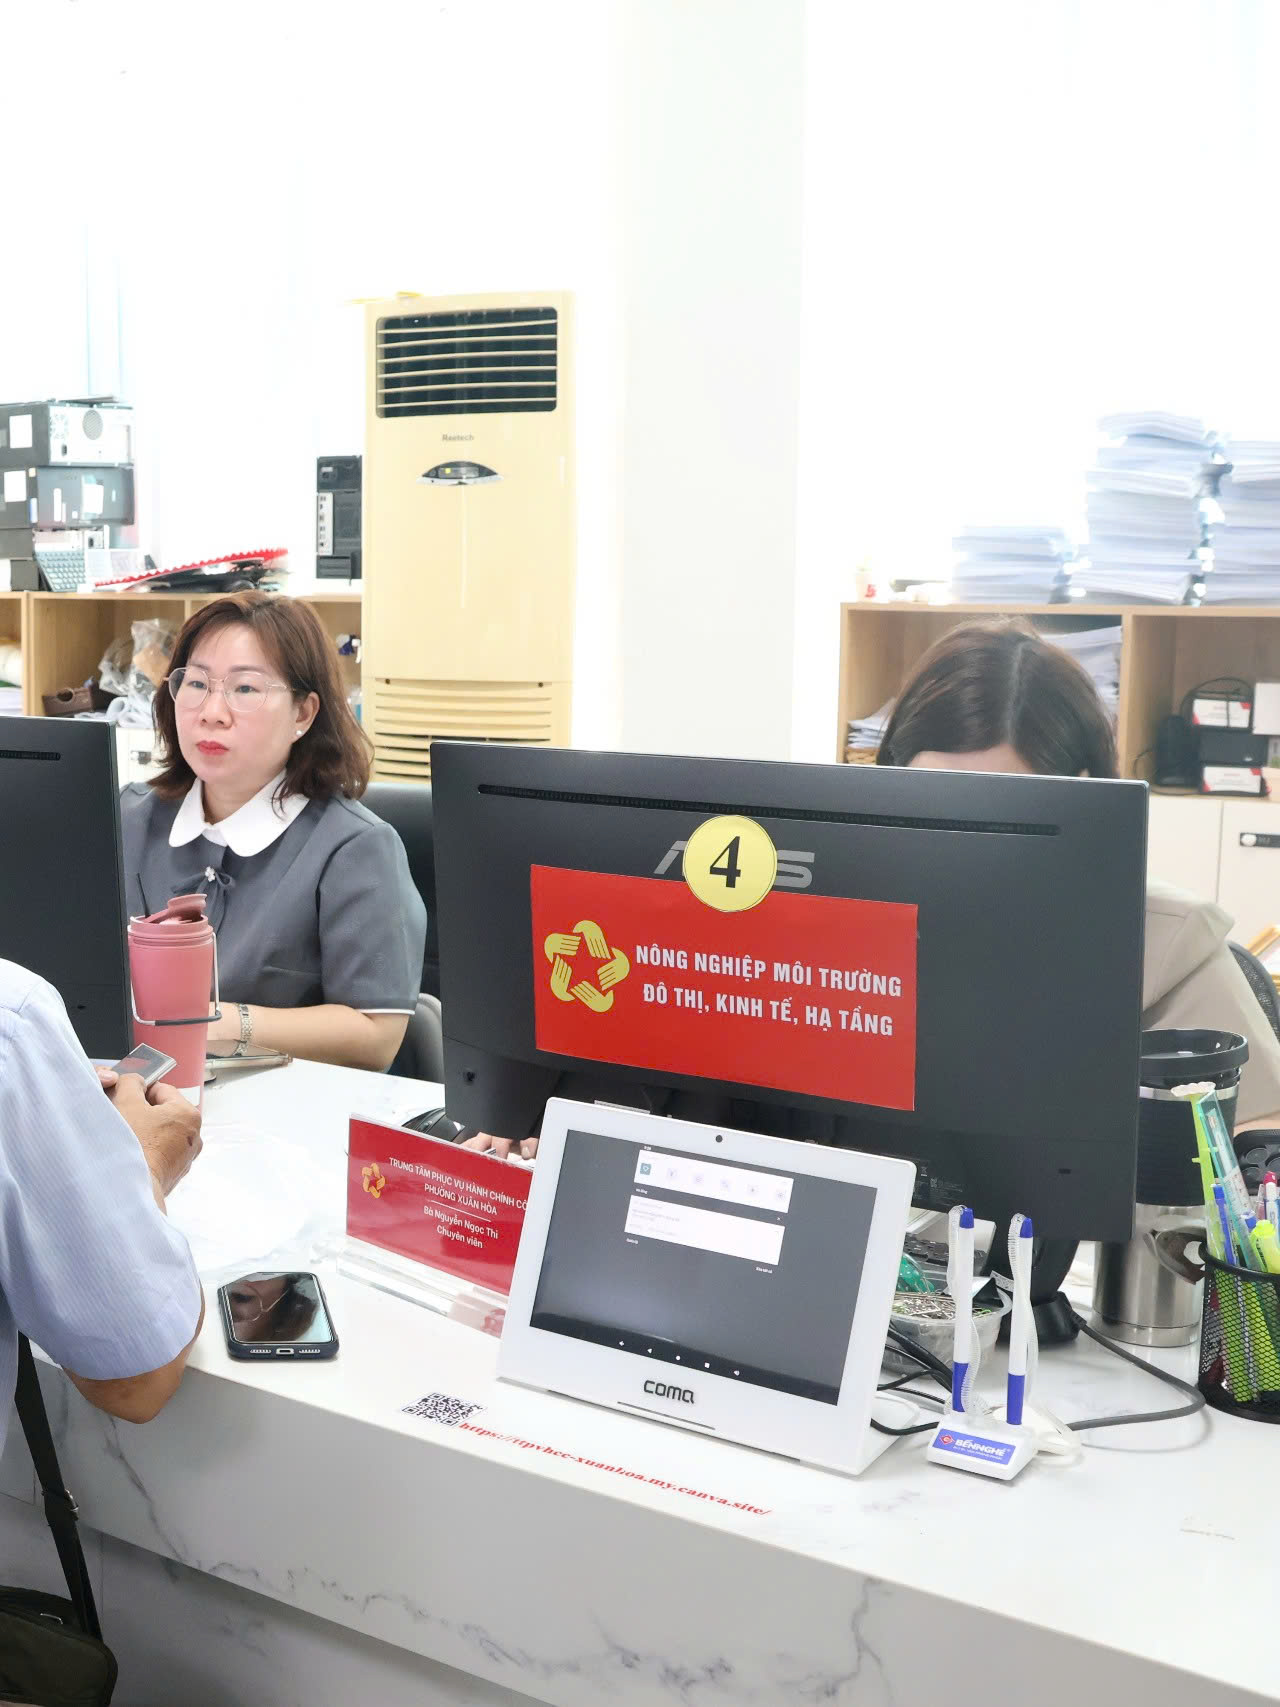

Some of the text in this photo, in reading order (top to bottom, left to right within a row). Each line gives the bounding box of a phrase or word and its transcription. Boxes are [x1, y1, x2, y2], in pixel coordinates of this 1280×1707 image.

[709, 835, 742, 889] 4
[636, 943, 902, 997] NÔNG NGHIỆP MÔI TRƯỜNG
[643, 982, 893, 1036] ĐÔ THỊ, KINH TẾ, HẠ TẦNG
[389, 1157, 414, 1173] TRUNG
[415, 1165, 431, 1179] TÂM
[431, 1172, 453, 1188] PHỤC
[454, 1180, 466, 1192] VỤ
[465, 1181, 489, 1199] HÀNH
[489, 1189, 515, 1206] CHÍNH
[424, 1183, 498, 1216] PHƯỜNG XUÂN HÒA
[423, 1205, 434, 1217] Bà
[434, 1210, 463, 1228] Nguyễn
[464, 1220, 485, 1235] Ngọc
[436, 1225, 483, 1249] Chuyên viên
[459, 1422, 772, 1516] https://ttpvhcc-xuanhoa.my.canva.site/
